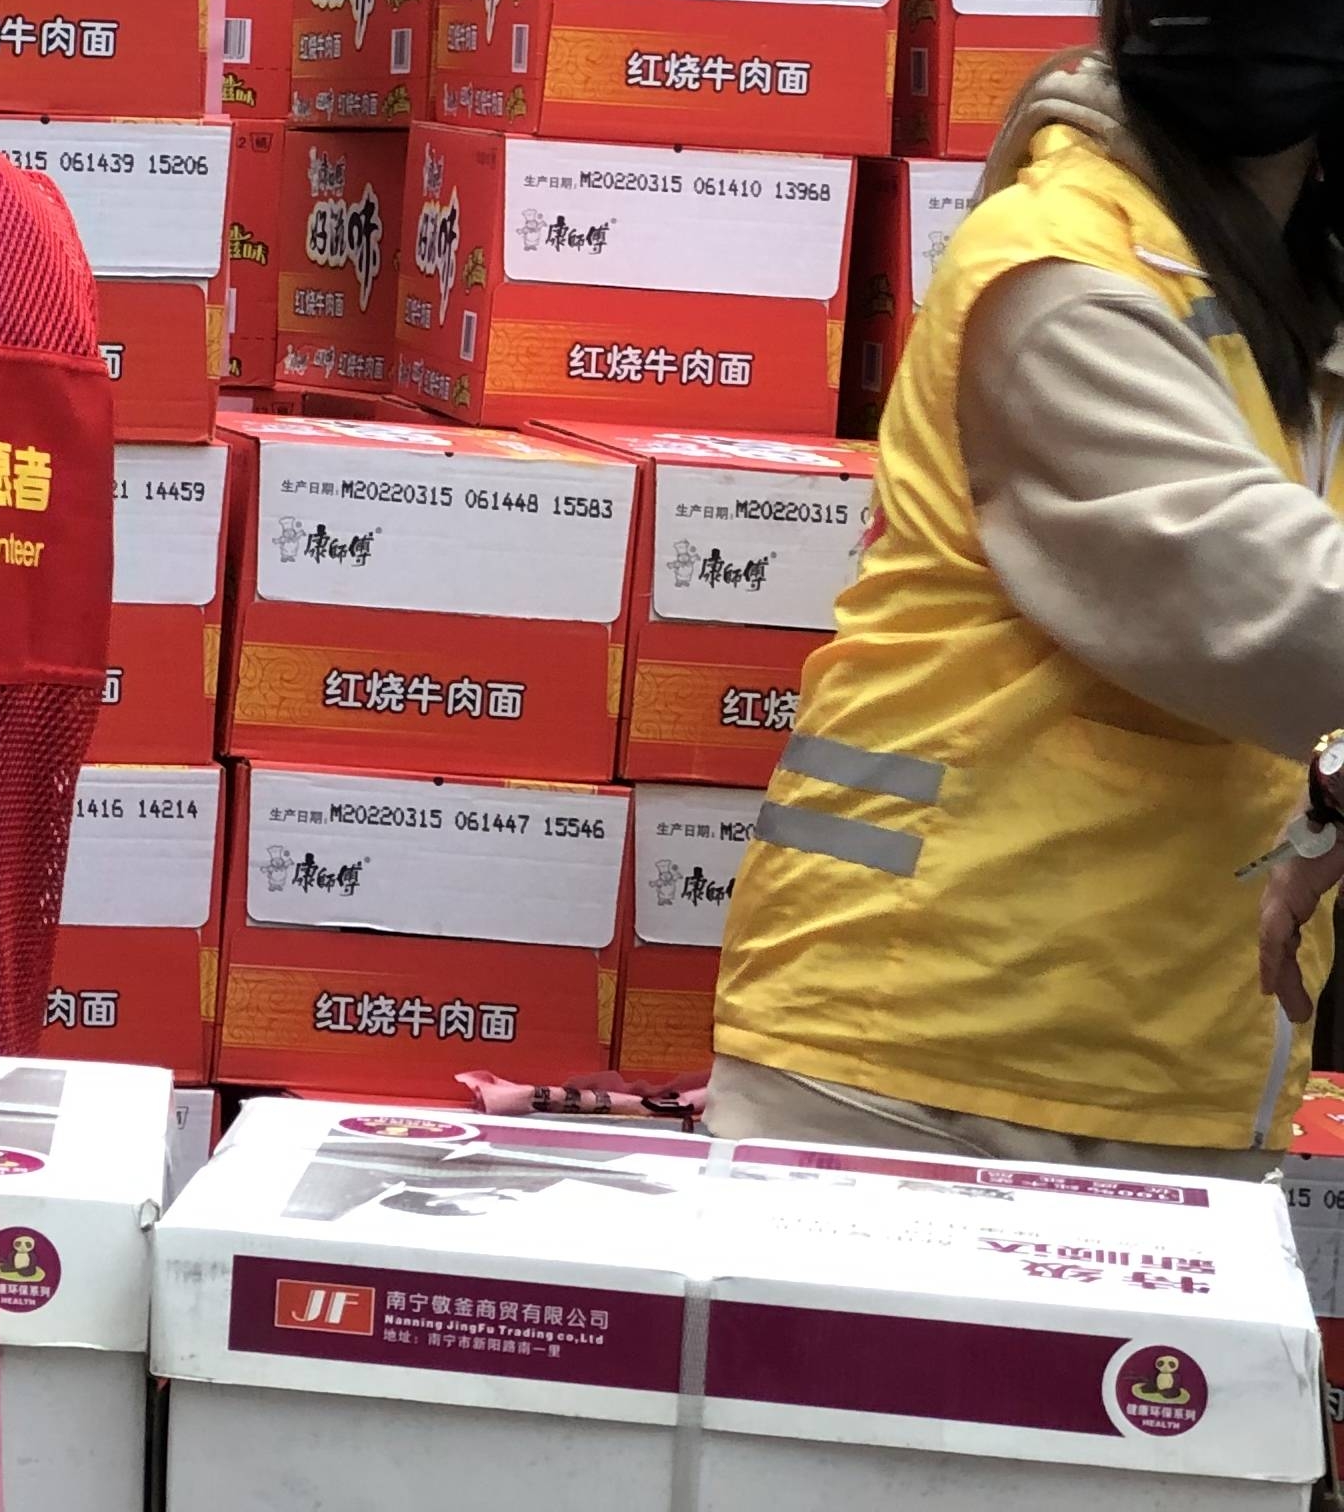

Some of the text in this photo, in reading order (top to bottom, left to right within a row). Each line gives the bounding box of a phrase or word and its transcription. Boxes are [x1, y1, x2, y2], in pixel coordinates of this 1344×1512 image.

[625, 51, 812, 96] 红烧牛肉面
[2, 151, 209, 175] 315 061439 15206
[580, 171, 683, 194] M20220315
[694, 176, 762, 198] 061410
[775, 180, 831, 202] 13968
[546, 215, 609, 255] 康師傅
[568, 344, 754, 386] 红烧牛肉面
[145, 482, 205, 502] 14459
[341, 480, 452, 507] M20220315
[465, 490, 539, 514] 061448
[553, 497, 613, 519] 15583
[736, 500, 848, 524] M20220315
[304, 524, 374, 567] 康師傅
[698, 548, 768, 591] 康師傅
[324, 670, 526, 719] 红烧牛肉面
[138, 800, 199, 819] 14214
[330, 804, 443, 829] M20220315
[455, 811, 530, 834] 061447
[544, 817, 605, 839] 15546
[292, 854, 361, 897] 康師傅
[314, 993, 519, 1041] 红烧牛肉面
[384, 1314, 443, 1331] Nanning
[446, 1320, 495, 1336] JingFu
[498, 1325, 554, 1342] Trading
